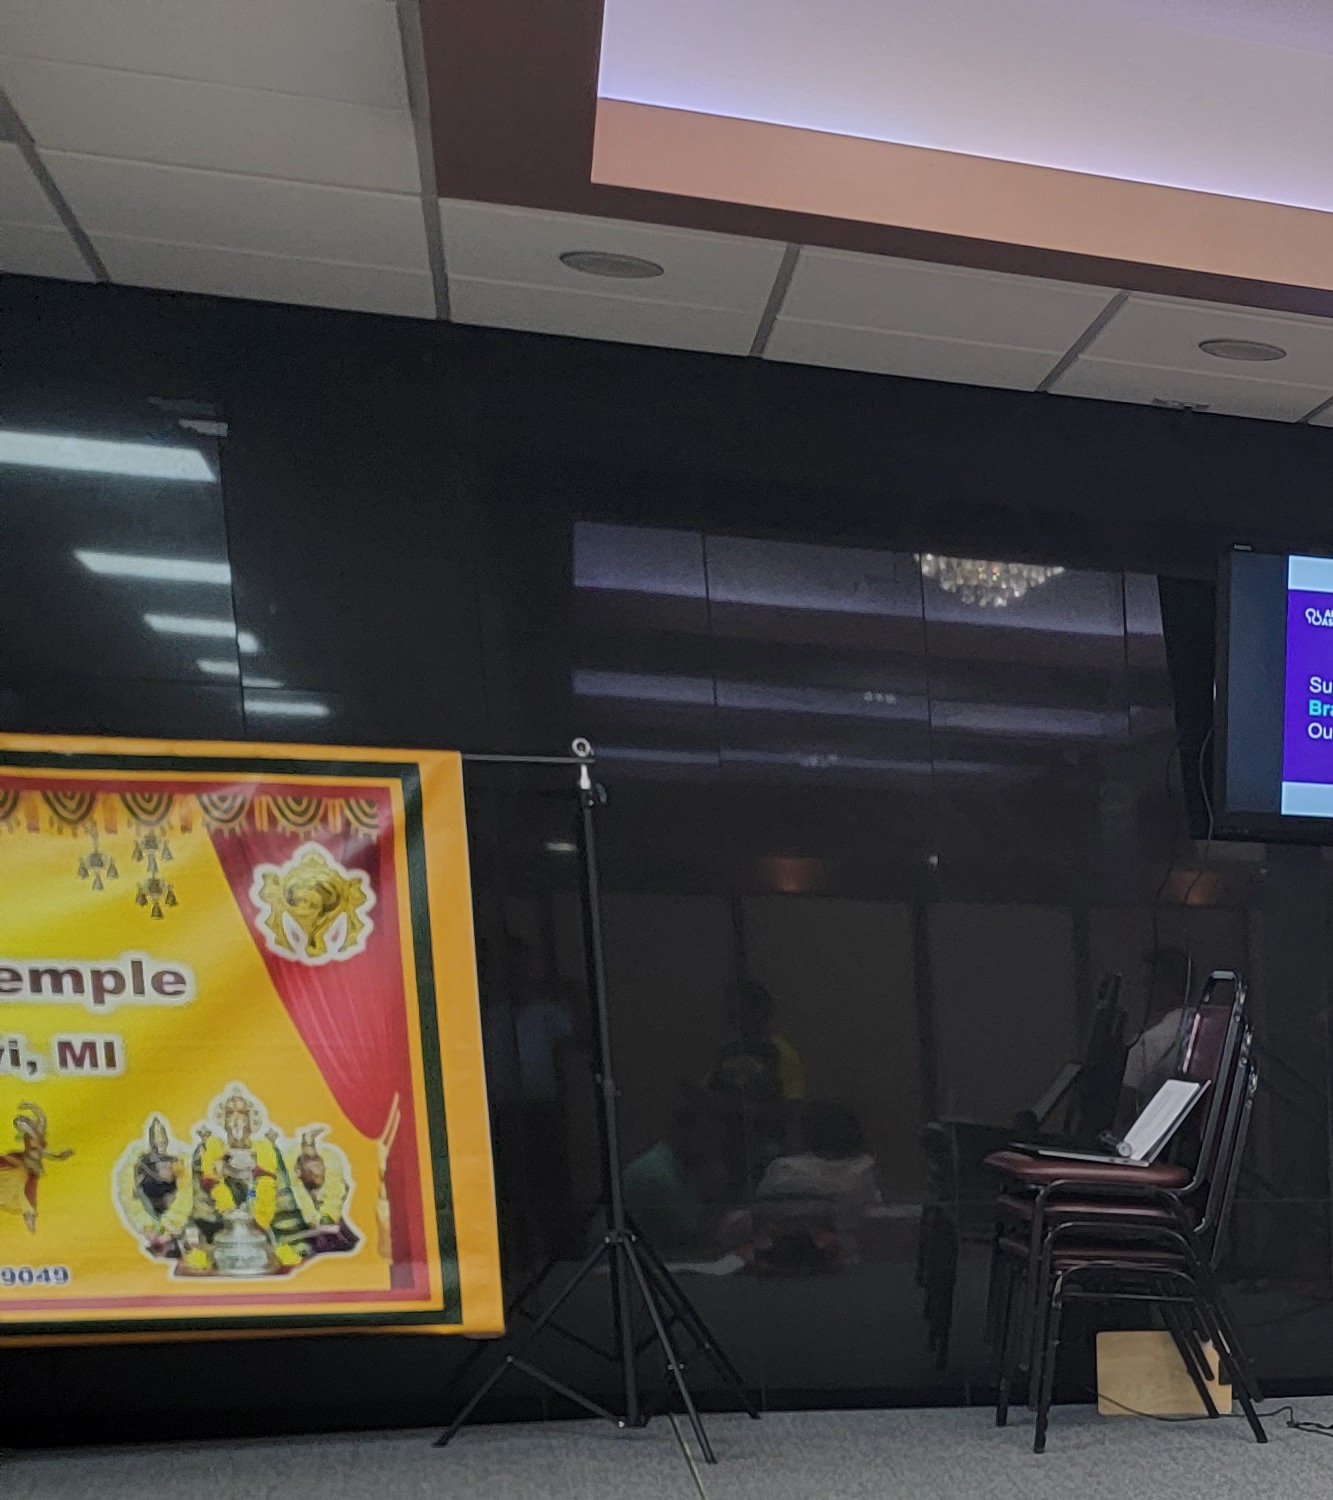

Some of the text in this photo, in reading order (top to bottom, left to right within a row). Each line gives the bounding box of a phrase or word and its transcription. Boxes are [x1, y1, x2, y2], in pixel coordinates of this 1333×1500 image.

[0, 1038, 117, 1076] i, MI
[0, 1266, 69, 1287] 9049
